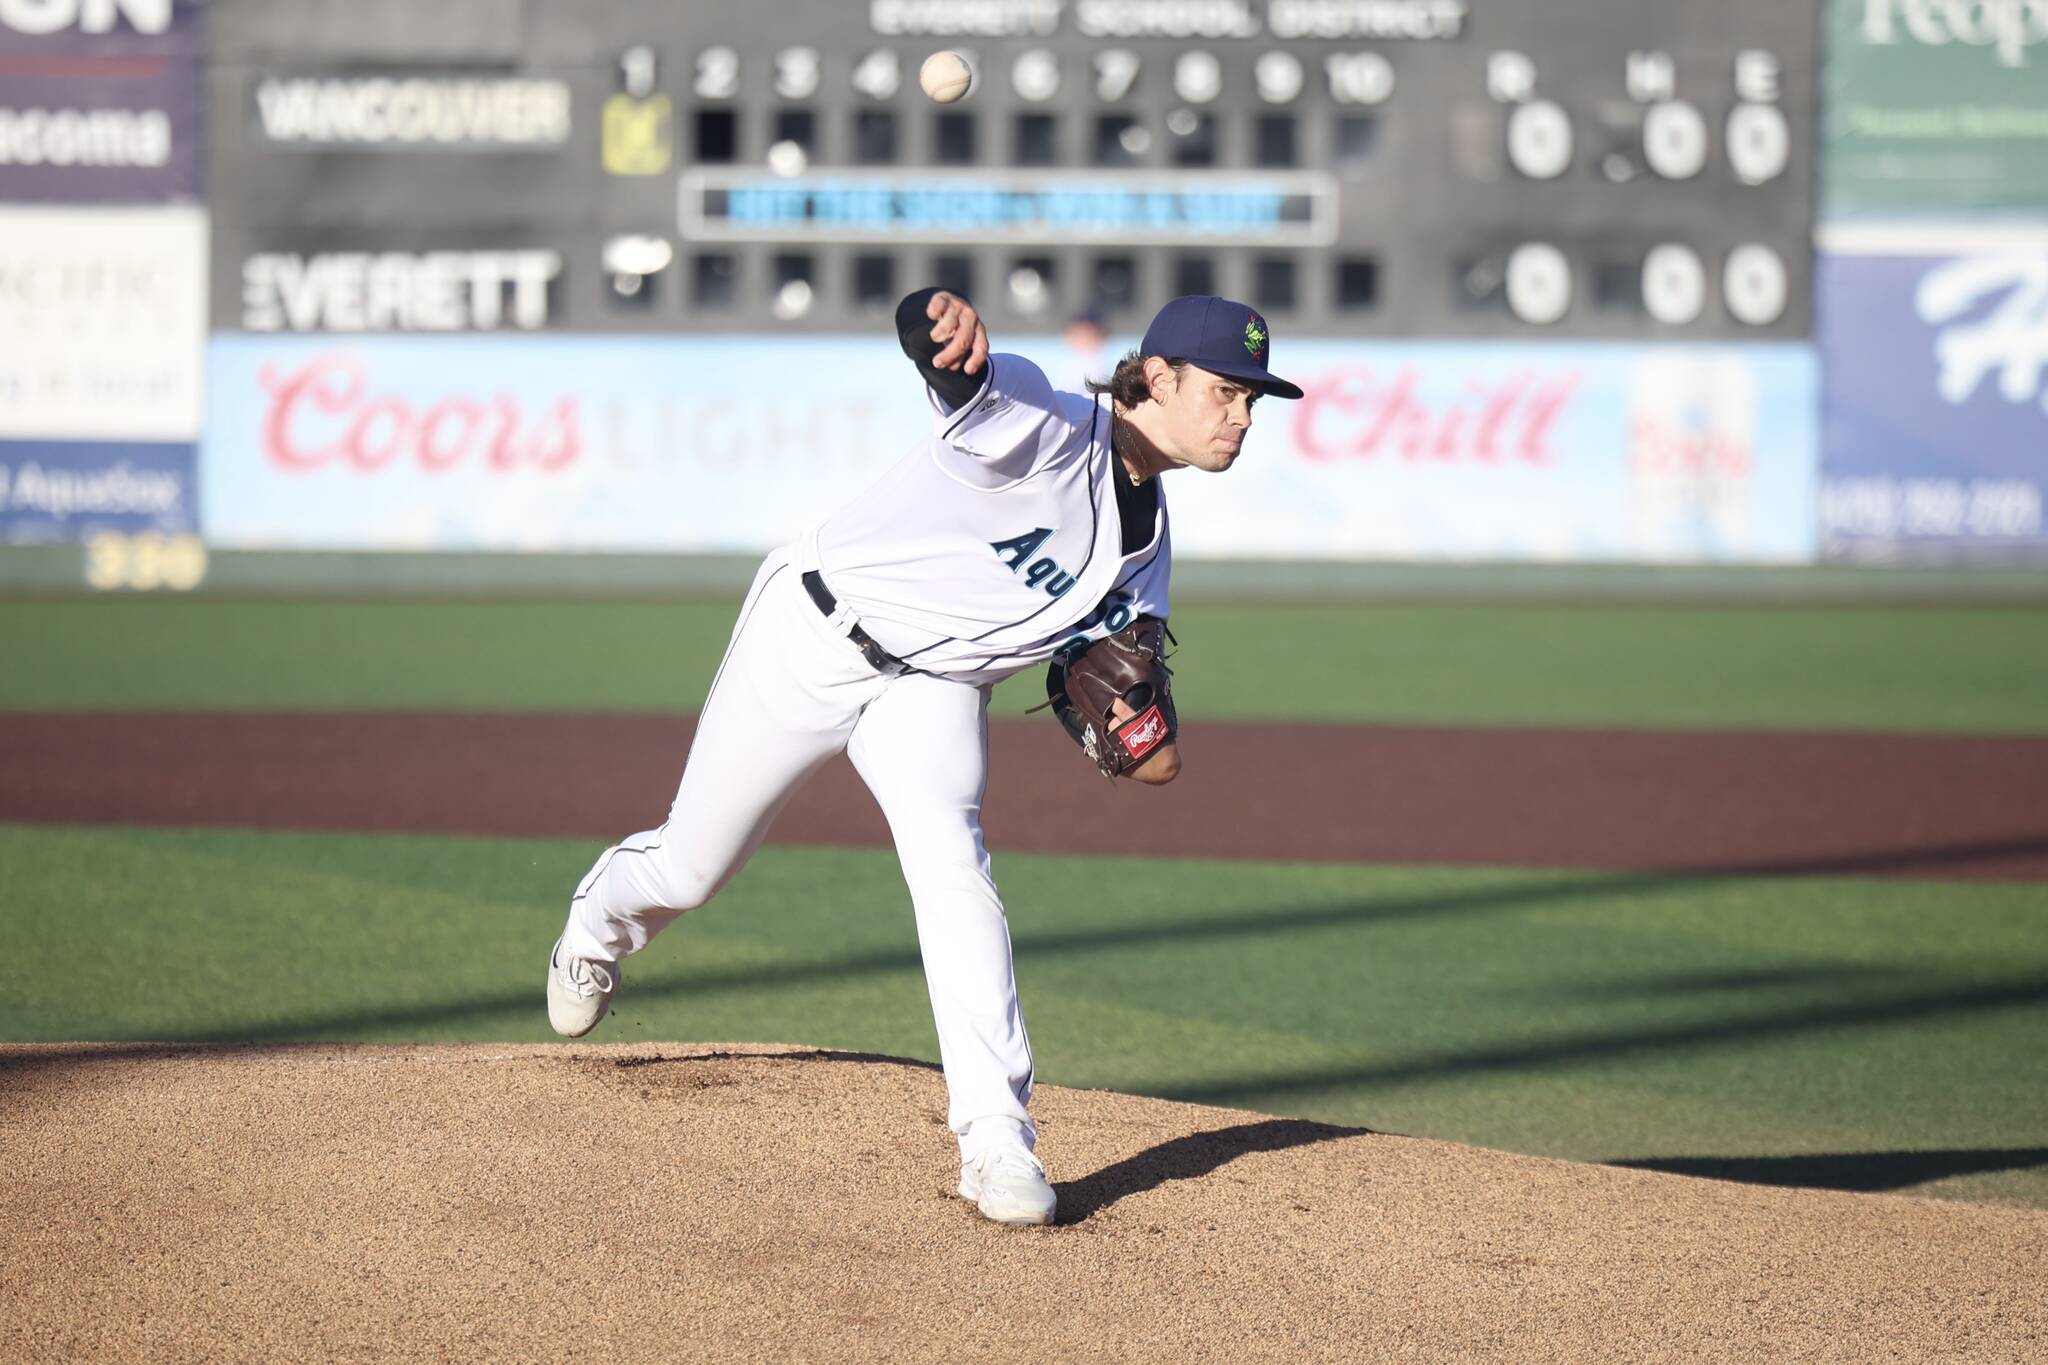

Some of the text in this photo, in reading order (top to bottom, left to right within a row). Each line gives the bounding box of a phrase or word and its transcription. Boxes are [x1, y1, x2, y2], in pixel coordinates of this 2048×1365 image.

[870, 0, 1465, 38] EVERETT SCHOOL DISTRICT
[257, 78, 571, 144] VANCOUVER
[619, 45, 656, 98] 1
[694, 46, 742, 99] 2
[775, 46, 820, 99] 3
[853, 48, 901, 99] 4
[1012, 50, 1060, 102] 6
[1094, 49, 1141, 103] 7
[1173, 50, 1222, 103] 8
[1255, 50, 1304, 103] 9
[1325, 50, 1396, 104] 10
[1626, 49, 1676, 102] H
[1734, 49, 1781, 102] E
[1508, 98, 1574, 180] 0
[1643, 98, 1708, 180] 0
[1725, 99, 1790, 181] 0
[242, 250, 561, 331] EVERETT
[1506, 242, 1788, 325] 0 0 0
[256, 347, 877, 476] Coors LIGHT
[1287, 362, 1583, 467] Chill
[14, 459, 182, 521] AquaSox
